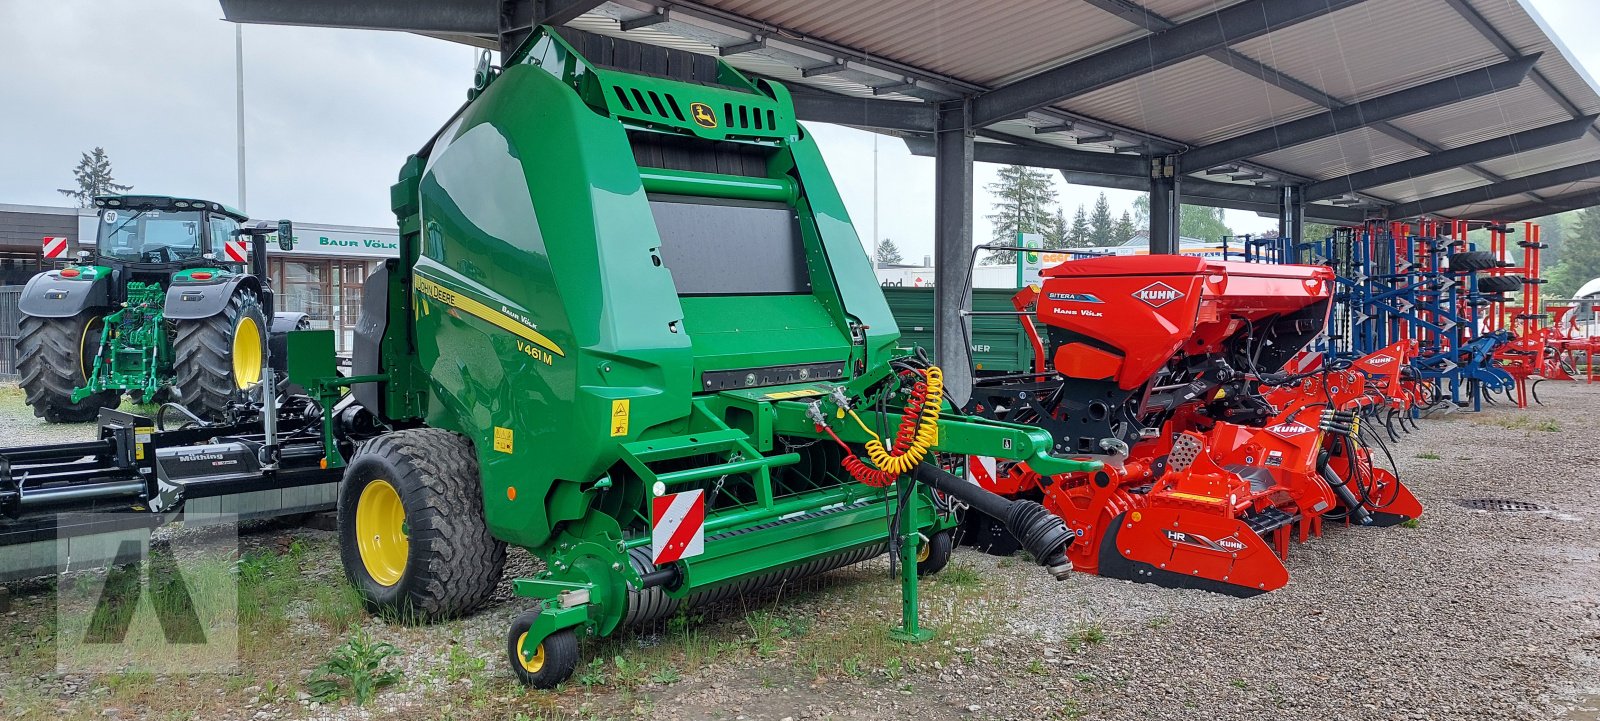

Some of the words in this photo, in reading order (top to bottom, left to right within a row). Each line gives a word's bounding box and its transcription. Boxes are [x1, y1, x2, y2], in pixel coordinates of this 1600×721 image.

[106, 212, 116, 222] 50
[319, 236, 359, 247] BAUR
[363, 239, 398, 249] VÖLK
[417, 278, 433, 297] JOHN
[433, 286, 456, 306] DEERE
[1140, 290, 1176, 300] KUHN
[501, 305, 520, 321] BAUR
[520, 314, 538, 330] VÖLK
[1081, 309, 1103, 317] VÖLK
[543, 353, 553, 366] M
[180, 452, 224, 462] Müthing
[1168, 531, 1186, 541] HR
[1220, 540, 1243, 549] KUHN
